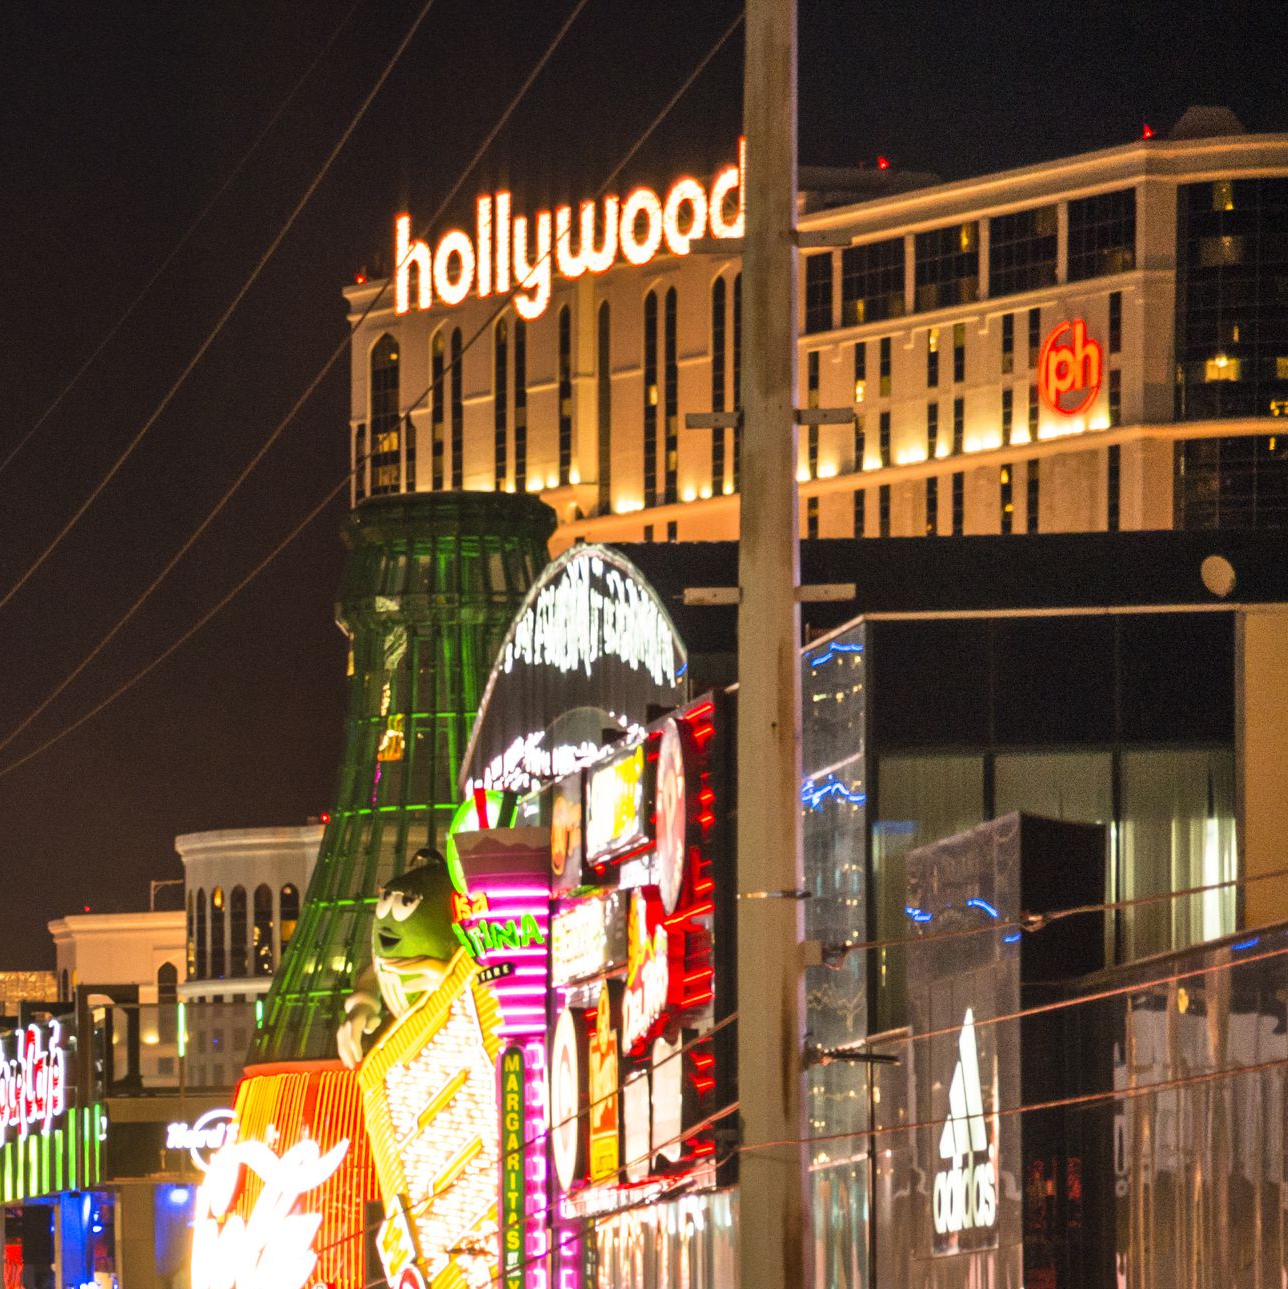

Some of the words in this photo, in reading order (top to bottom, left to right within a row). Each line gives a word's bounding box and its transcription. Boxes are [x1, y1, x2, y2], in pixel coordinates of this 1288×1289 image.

[394, 136, 747, 320] hollywood
[504, 1053, 521, 1250] MARGARITAS
[932, 1150, 997, 1234] adidas
